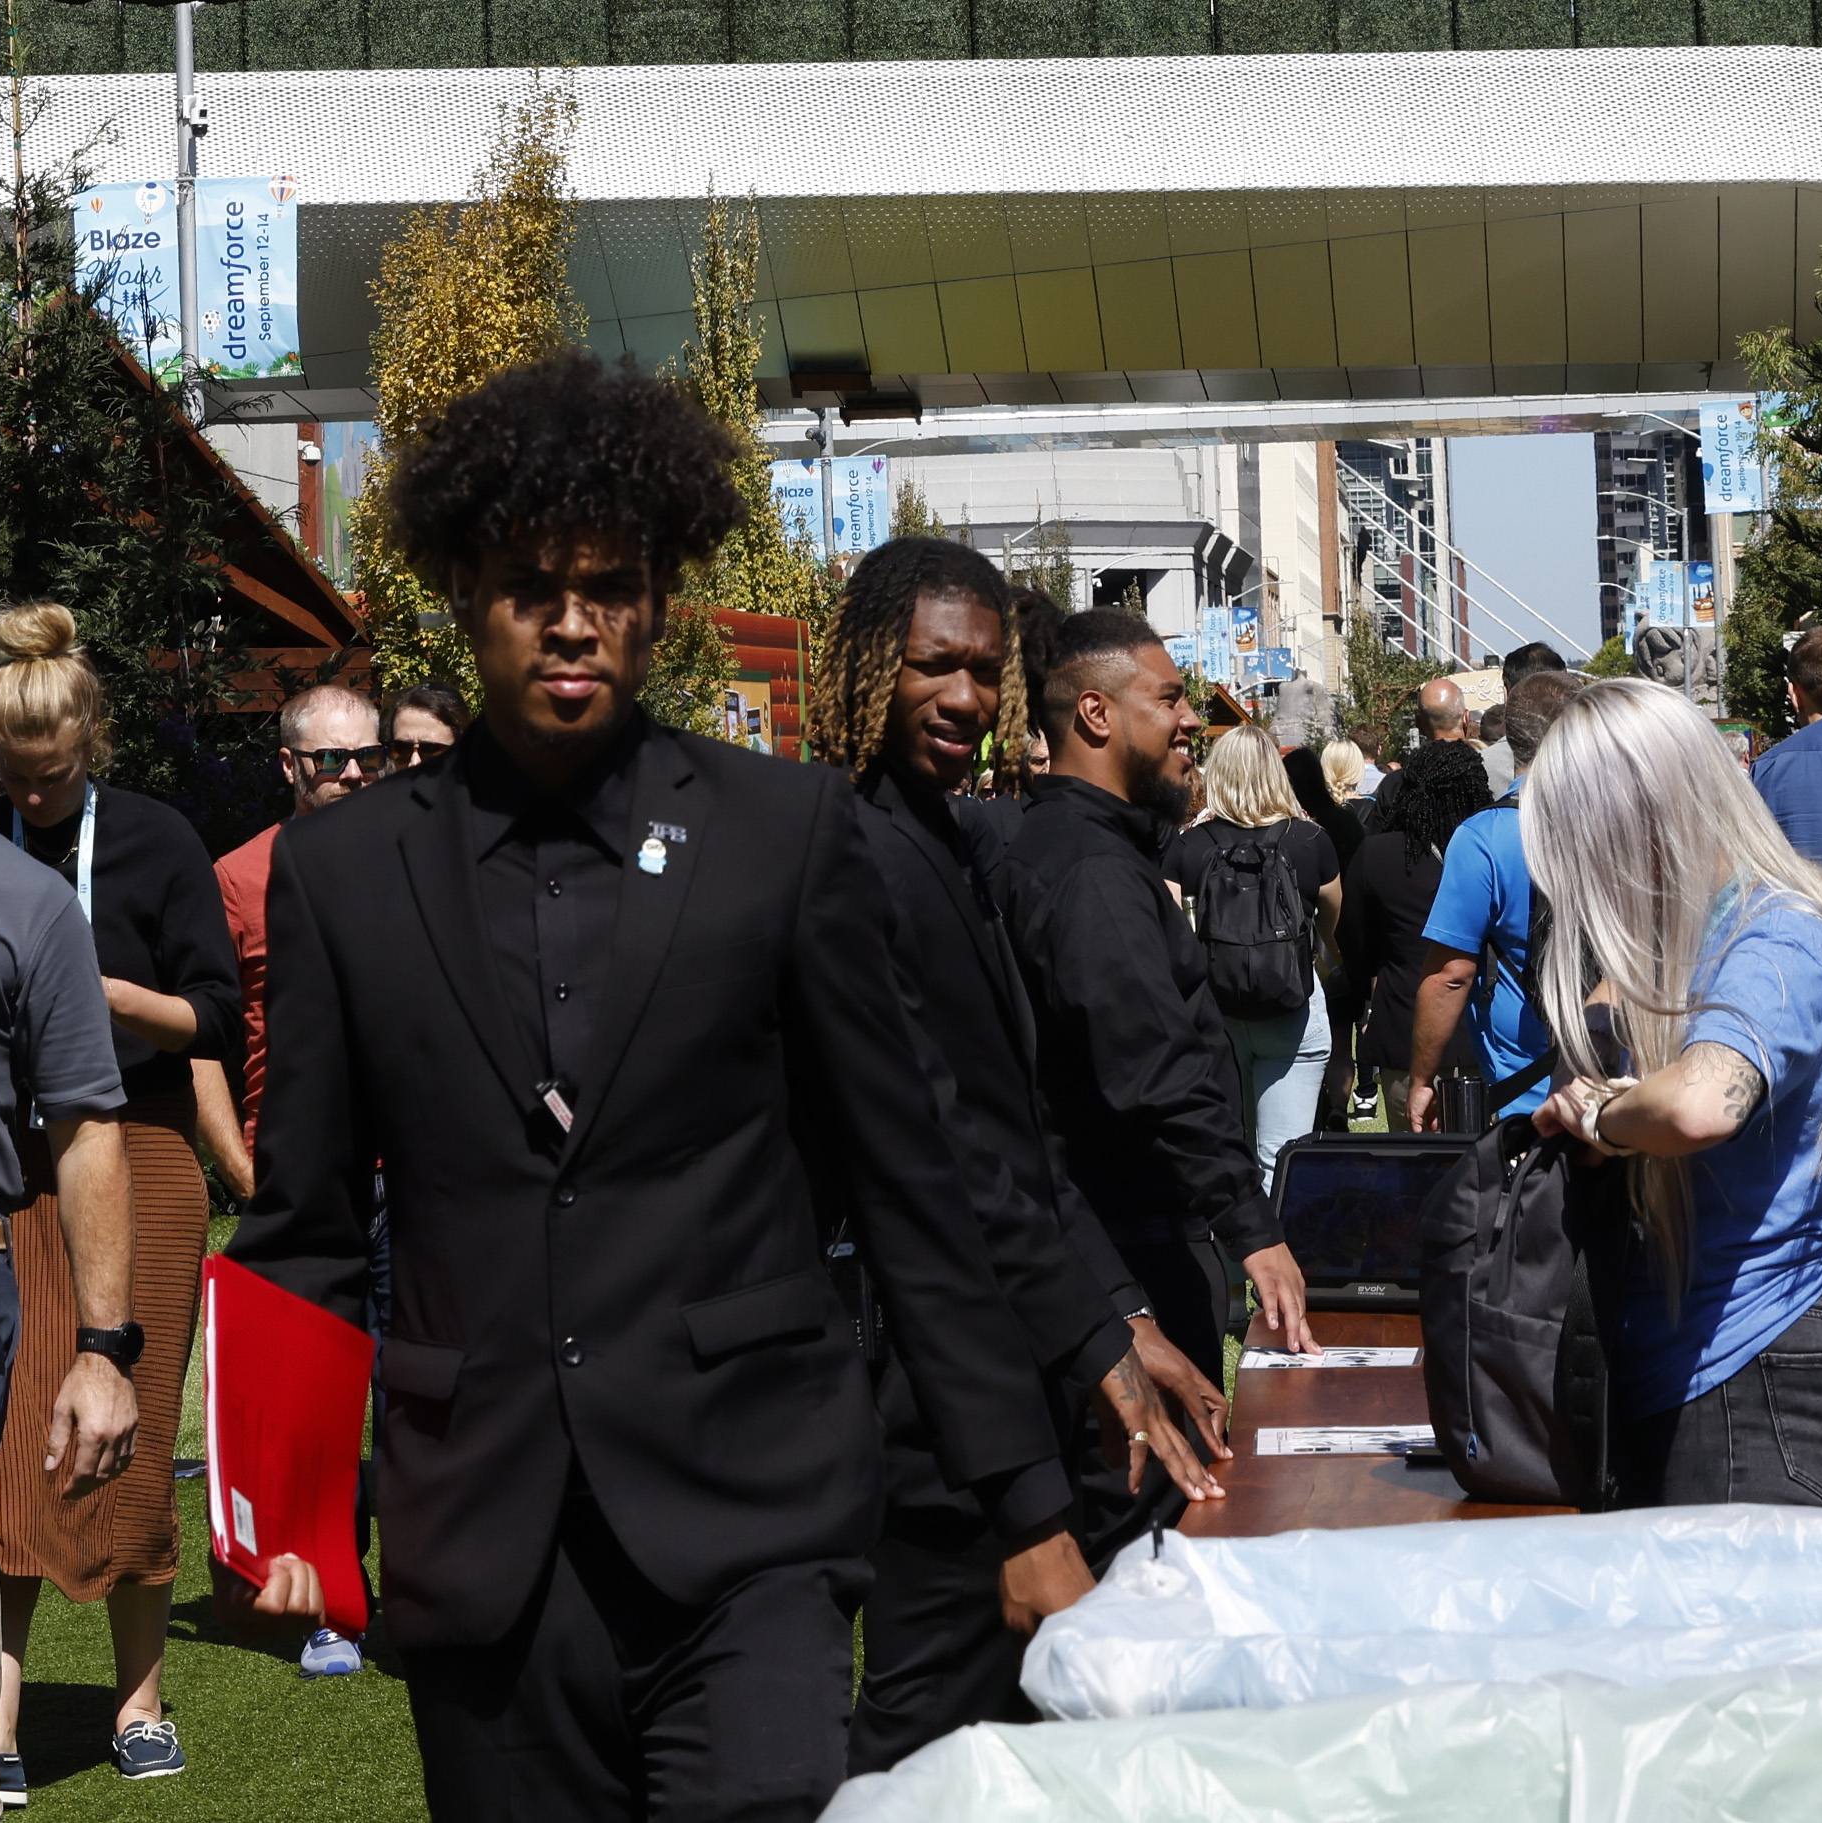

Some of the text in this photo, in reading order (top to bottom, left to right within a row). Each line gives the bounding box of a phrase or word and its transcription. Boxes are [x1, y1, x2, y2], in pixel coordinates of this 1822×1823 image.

[90, 229, 161, 251] Blaze
[85, 257, 163, 287] Your
[220, 201, 251, 360] dreamforce
[257, 213, 272, 341] September 12-14
[1716, 415, 1734, 502] dreamforce
[777, 486, 814, 498] Blaze
[867, 498, 876, 547] September
[1658, 568, 1667, 621] dreamforce
